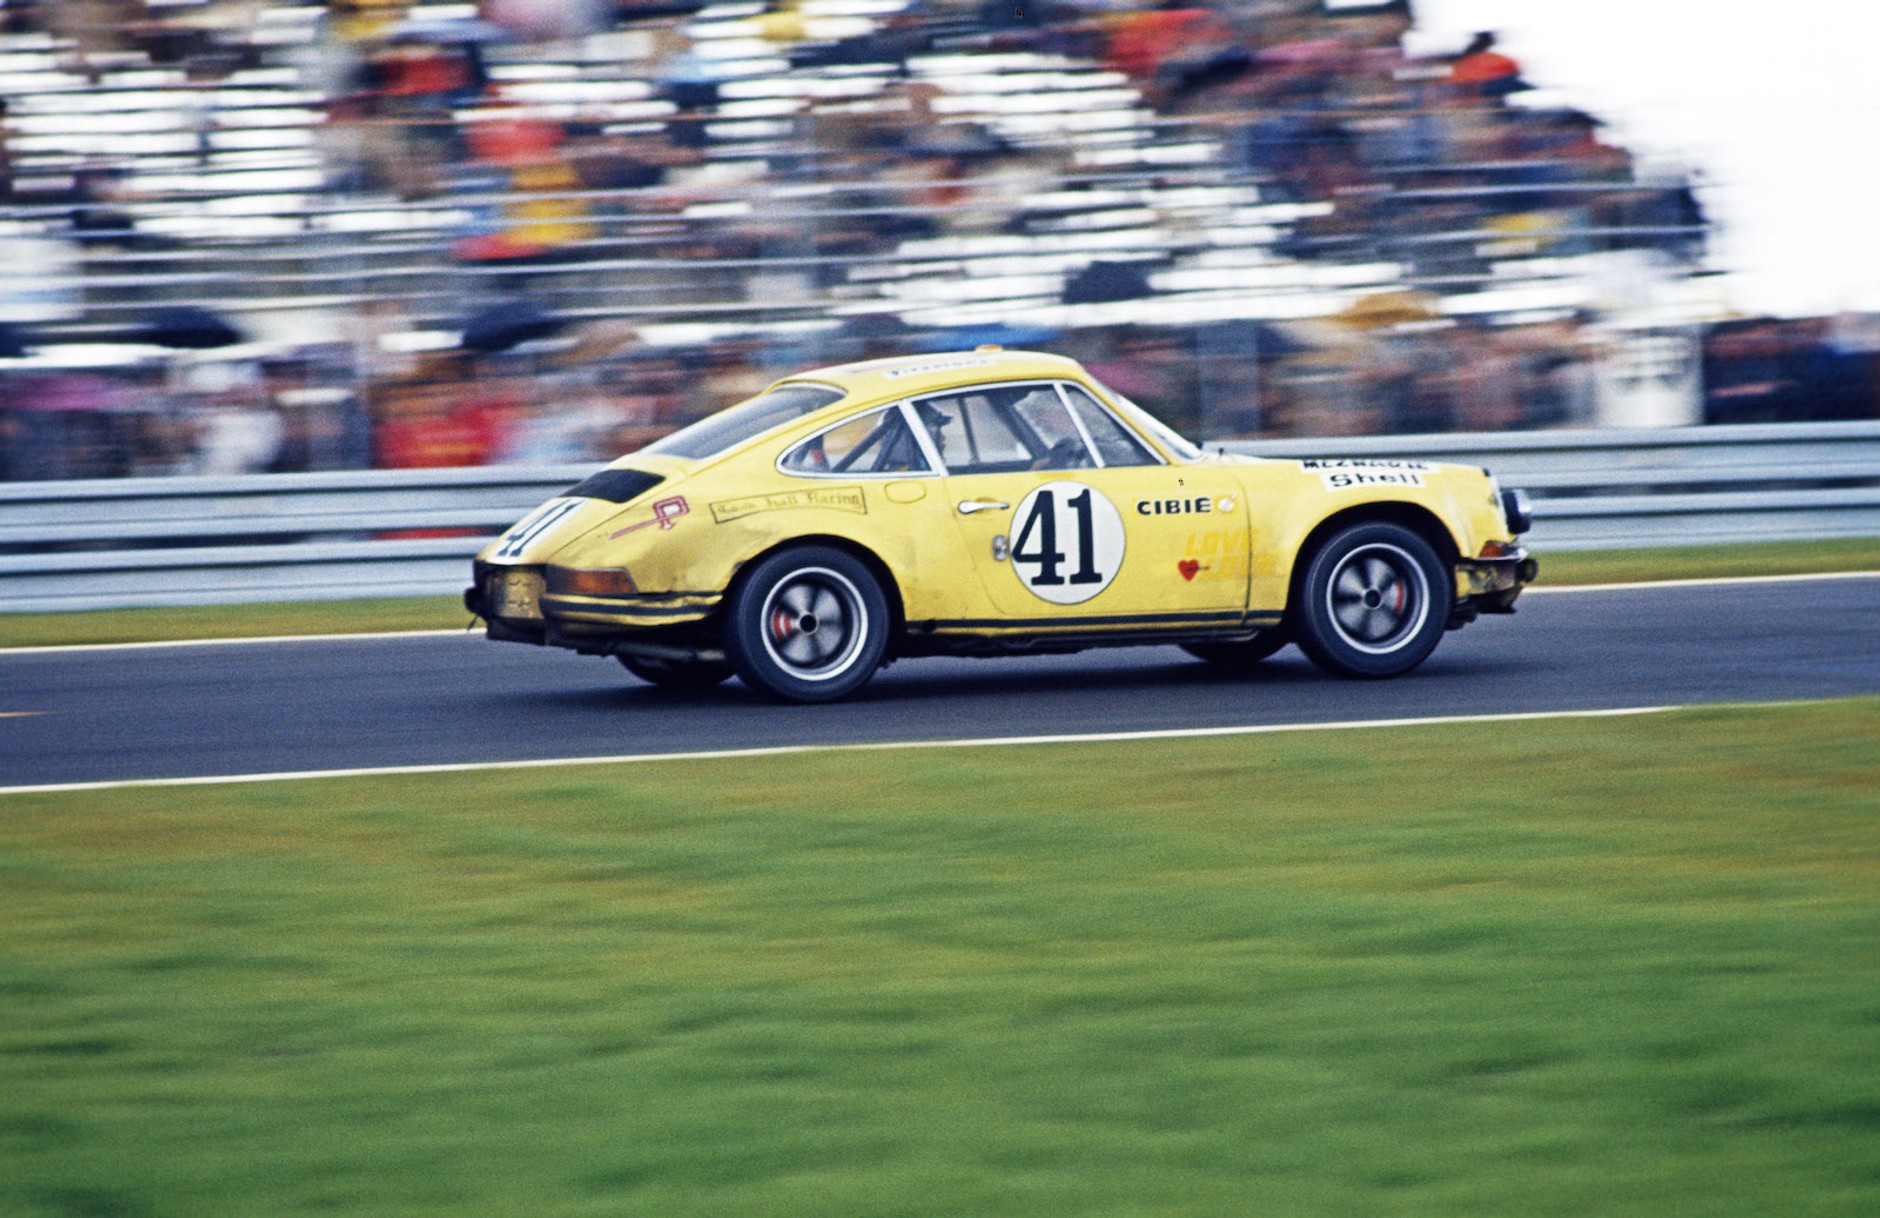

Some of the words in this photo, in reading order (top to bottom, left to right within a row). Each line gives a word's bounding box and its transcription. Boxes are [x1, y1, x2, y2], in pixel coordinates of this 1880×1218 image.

[1330, 473, 1419, 487] Shell
[1137, 497, 1212, 515] CIBIE
[497, 498, 587, 557] 41
[1011, 488, 1103, 585] 41
[1184, 528, 1260, 557] LOVE
